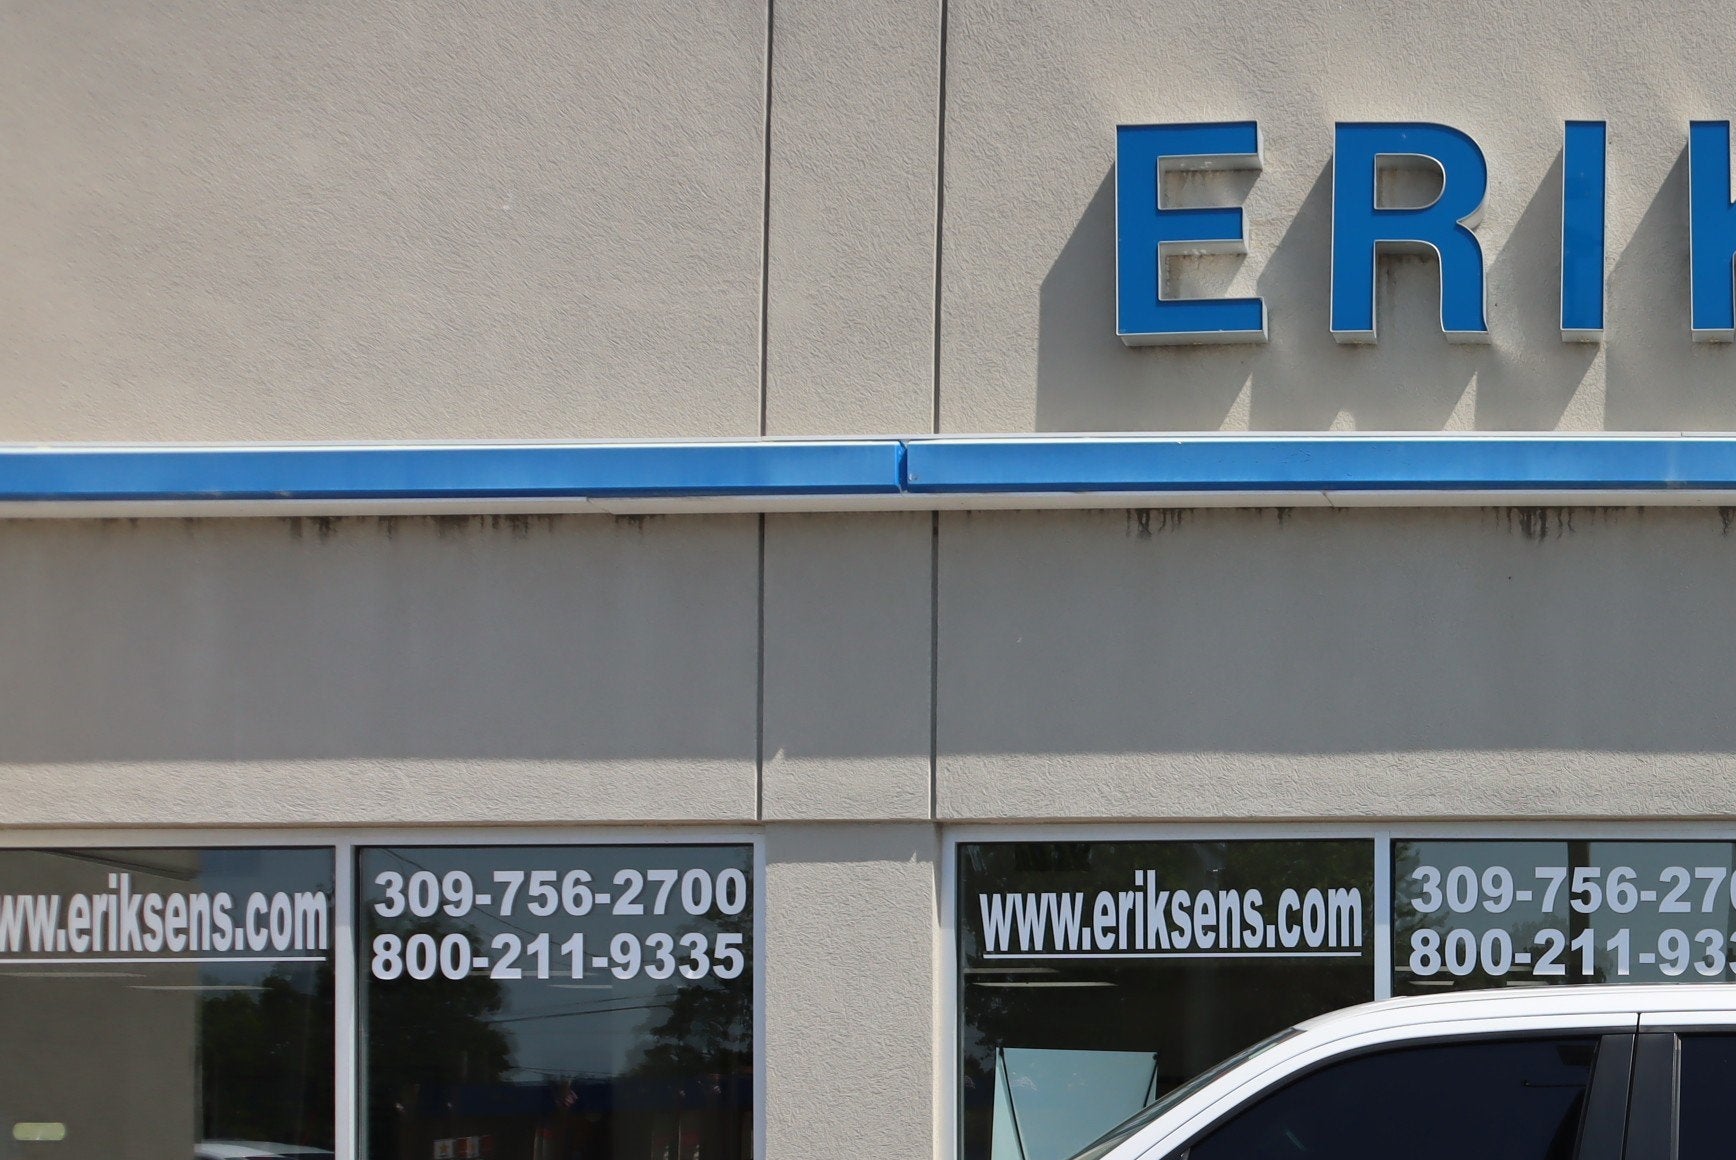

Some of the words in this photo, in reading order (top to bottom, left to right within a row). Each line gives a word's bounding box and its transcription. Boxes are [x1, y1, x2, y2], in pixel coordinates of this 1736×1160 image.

[373, 868, 748, 918] 309-756-2700
[980, 870, 1363, 950] www.eriksens.com
[371, 933, 746, 981] 800-211-9335
